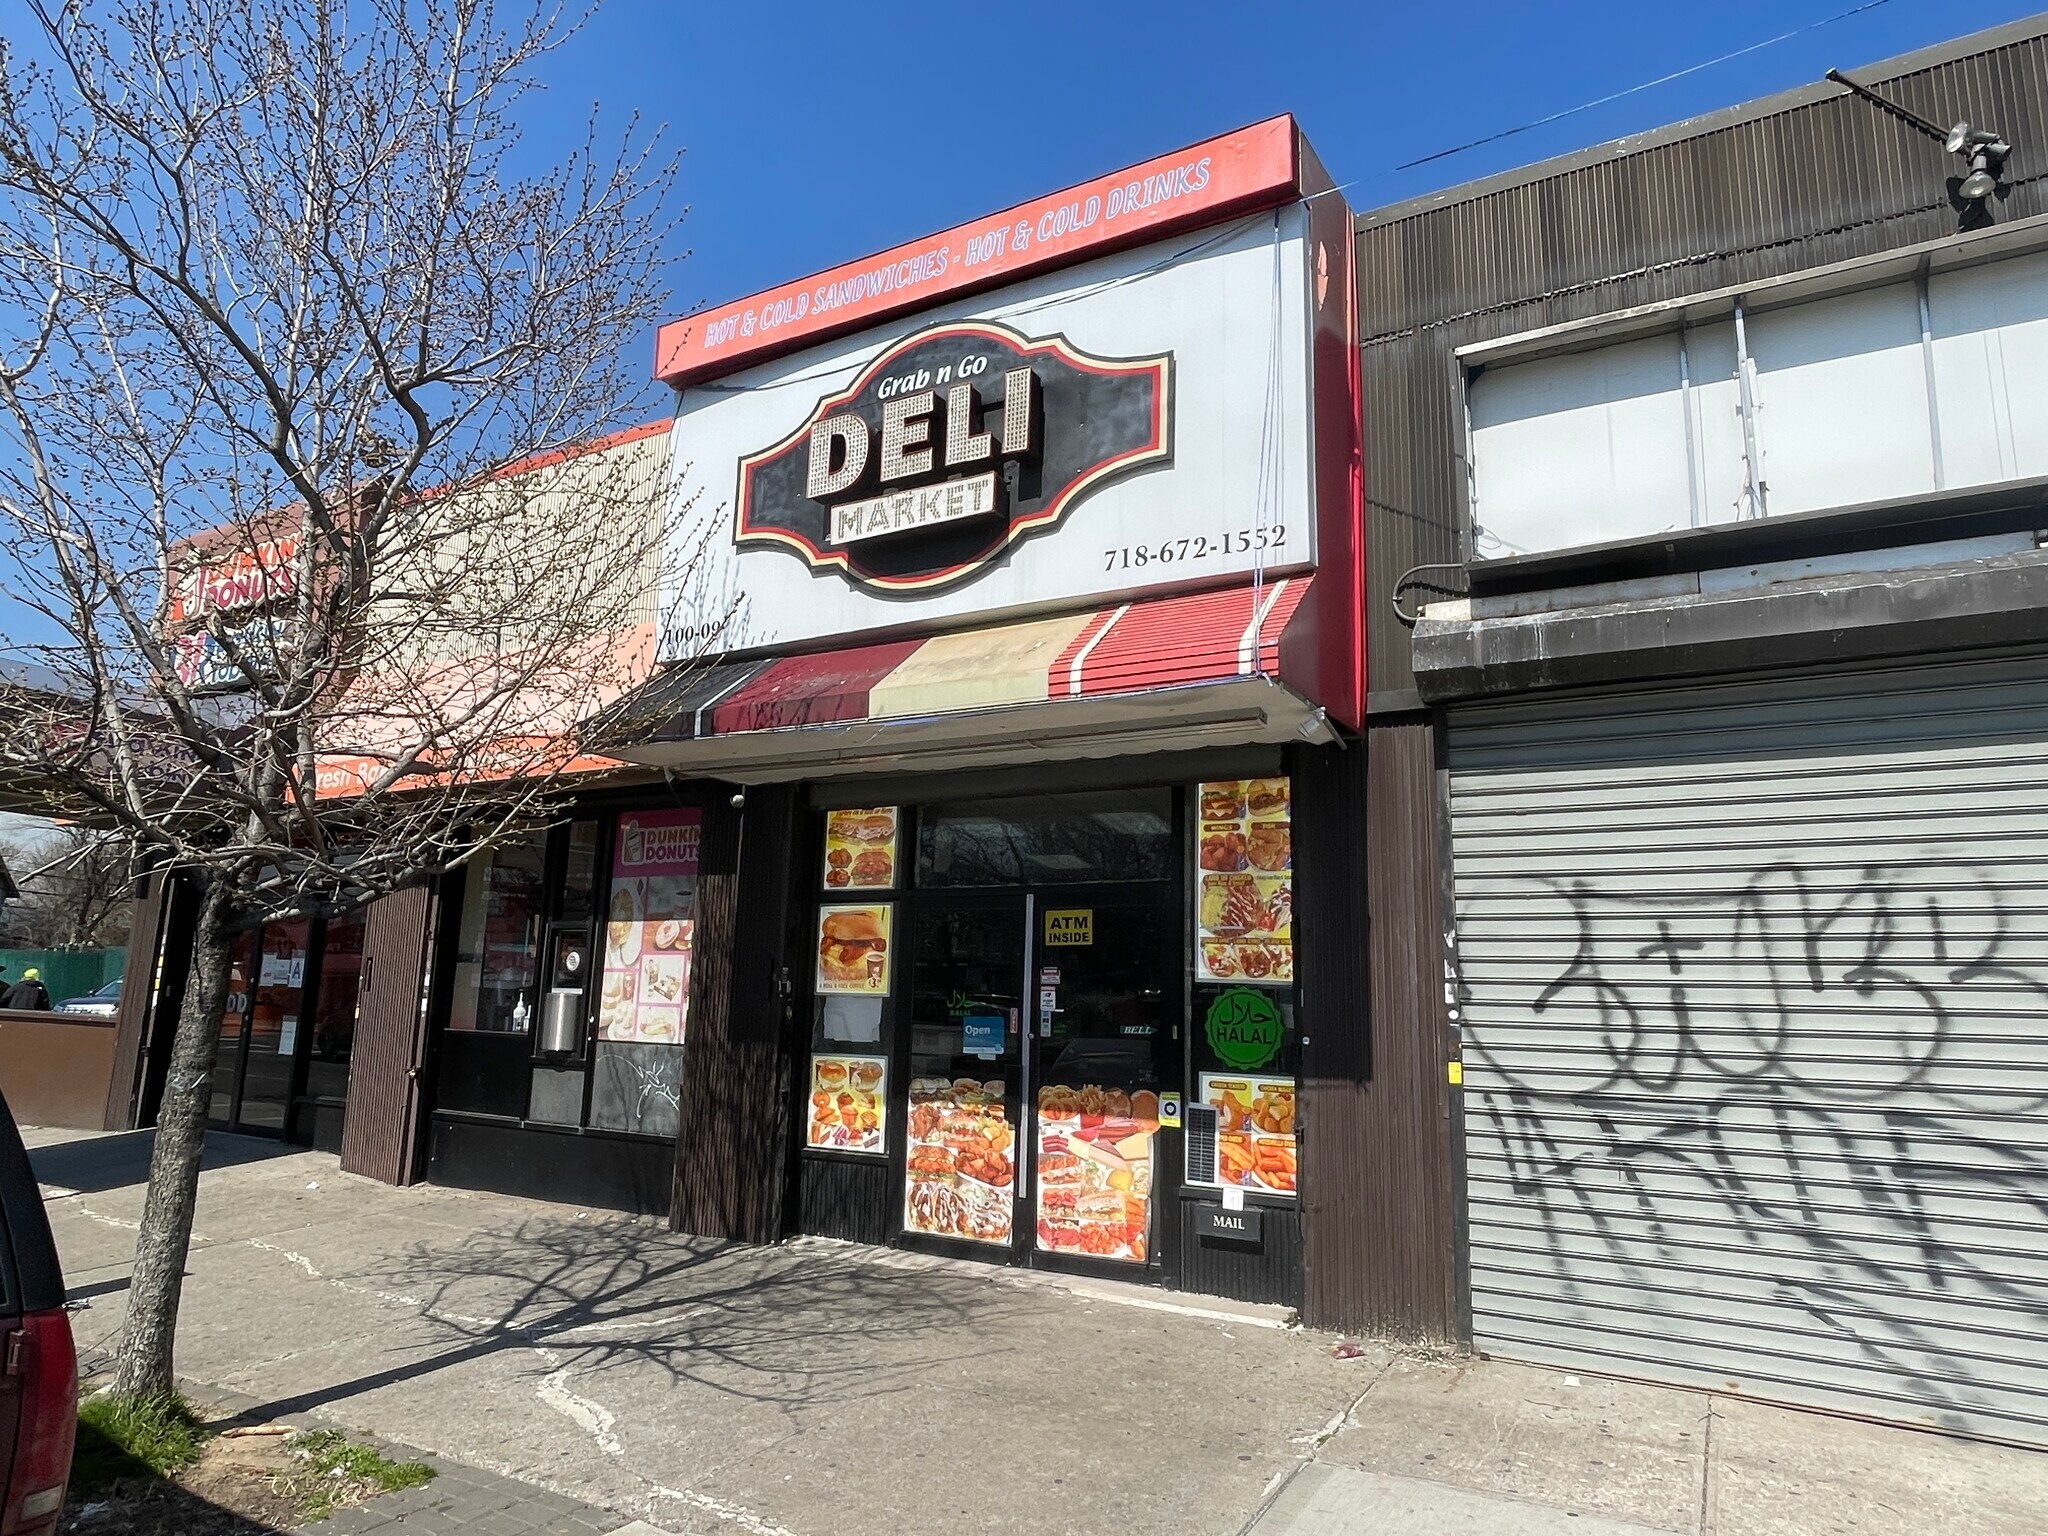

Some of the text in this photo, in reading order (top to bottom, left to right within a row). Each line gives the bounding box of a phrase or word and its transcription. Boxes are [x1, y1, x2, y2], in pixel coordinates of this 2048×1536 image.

[704, 313, 740, 348] HOT
[740, 310, 757, 338] &
[760, 297, 809, 332] COLD
[811, 246, 949, 316] SANDWICHES
[964, 225, 1010, 267] HOT
[1012, 220, 1033, 251] &
[1037, 196, 1100, 243] COLD
[1106, 157, 1211, 221] DRINKS
[877, 354, 988, 400] Grab n Go
[806, 366, 1034, 499] DELI
[837, 480, 990, 540] MARKET
[1104, 524, 1287, 572] 718-672-1552
[1050, 916, 1088, 930] ATM
[1048, 932, 1090, 944] INSIDE
[965, 1024, 991, 1037] Open
[1123, 1025, 1154, 1035] BELL
[1216, 1026, 1274, 1045] HALAL
[1213, 1215, 1246, 1231] MAIL
